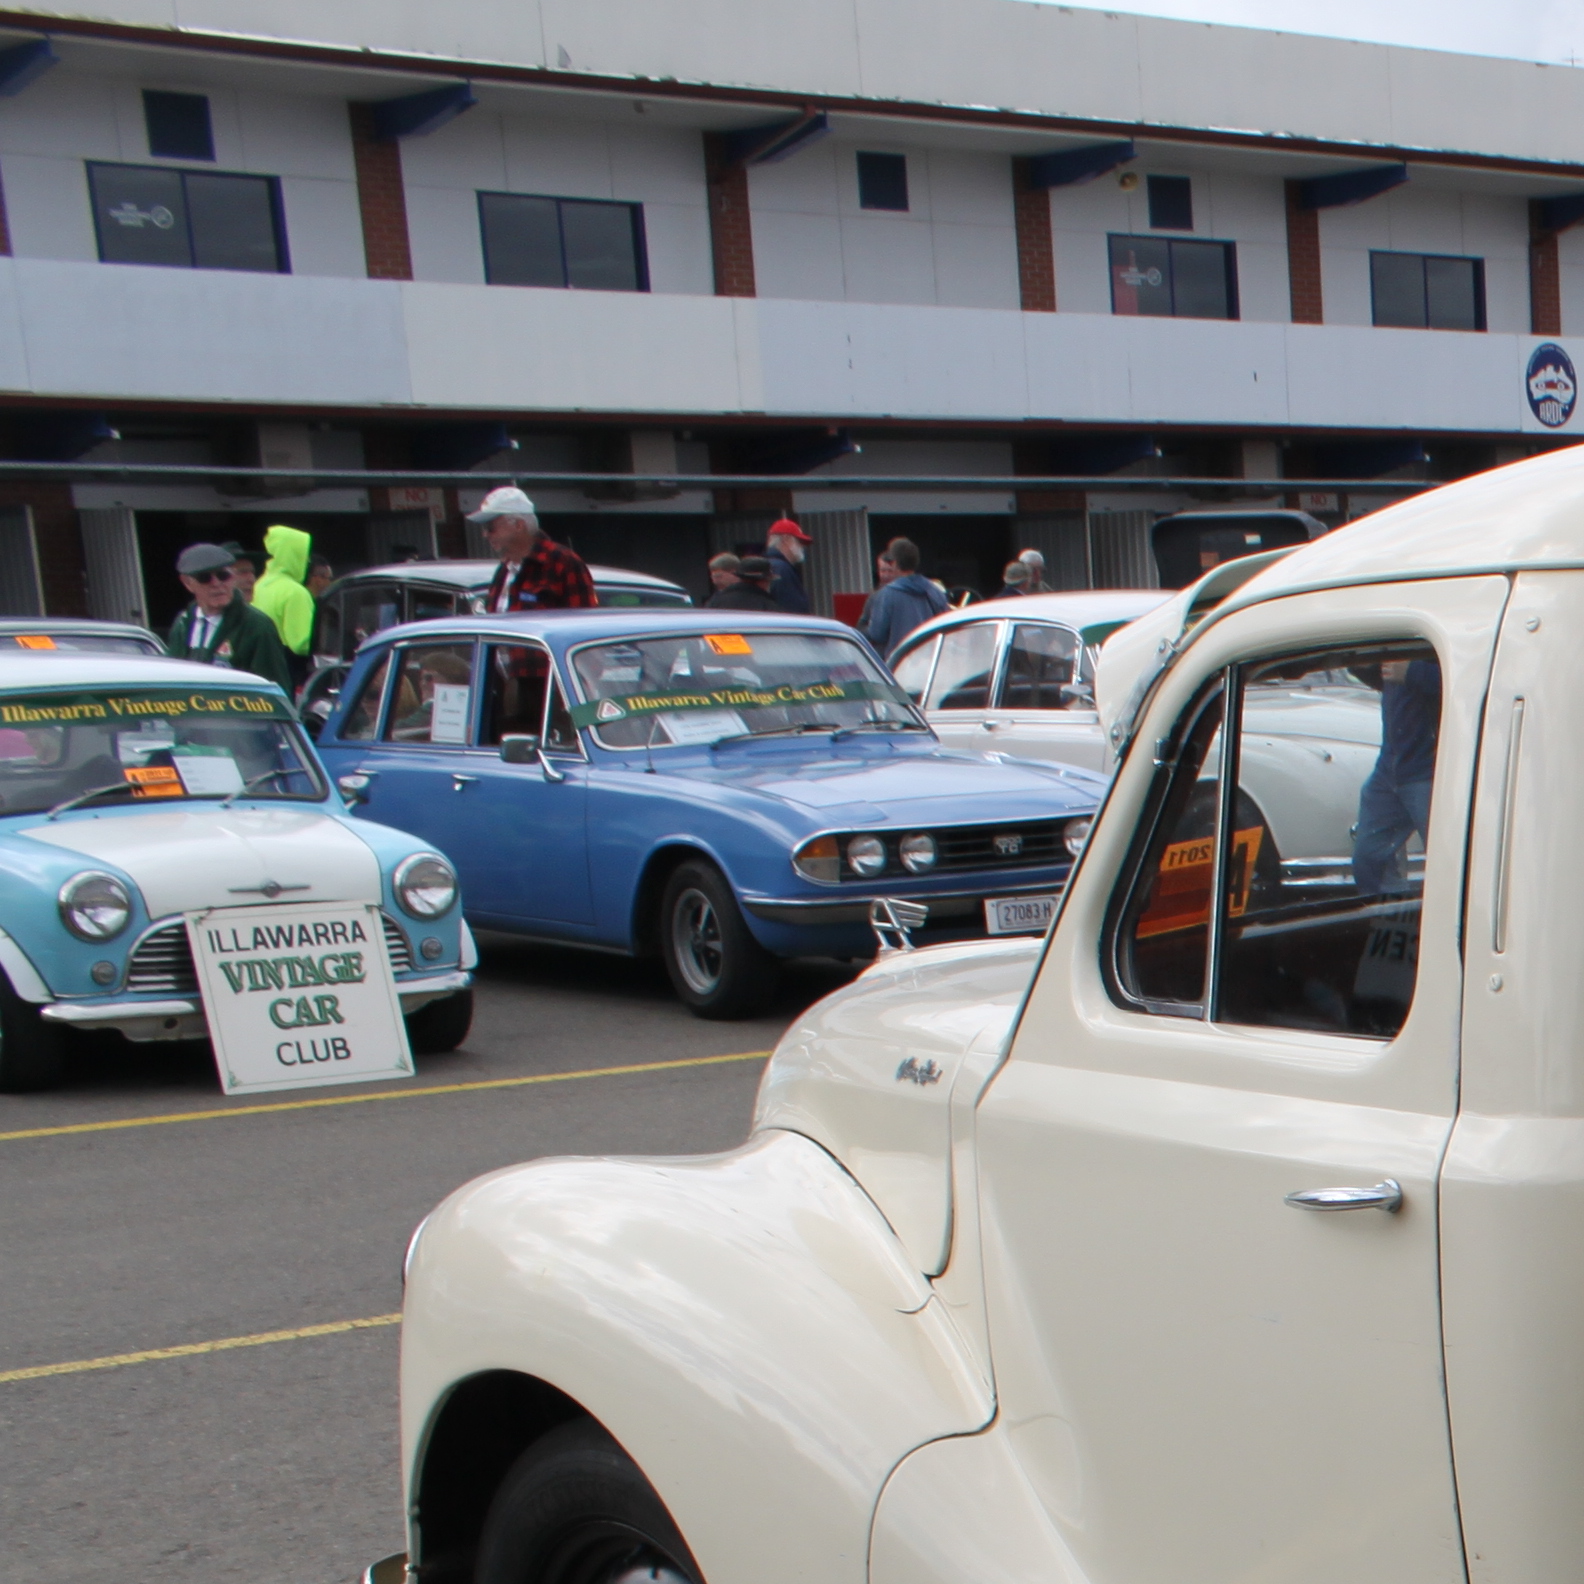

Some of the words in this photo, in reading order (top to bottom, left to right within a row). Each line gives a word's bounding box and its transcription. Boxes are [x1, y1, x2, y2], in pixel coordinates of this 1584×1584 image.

[405, 487, 428, 503] NO
[1, 702, 107, 723] Illawarra
[106, 697, 189, 716] Vintage
[189, 694, 227, 712] Car
[228, 696, 275, 714] Club
[626, 695, 712, 711] Illawarra
[711, 690, 776, 706] Vintage
[777, 686, 807, 702] Car
[808, 683, 846, 700] Club
[1004, 903, 1040, 923] 27083
[1042, 901, 1052, 918] H
[207, 919, 368, 954] ILLAWARRA
[218, 951, 368, 995] VINTAGE
[268, 994, 346, 1030] CAR
[275, 1036, 352, 1067] CLUB
